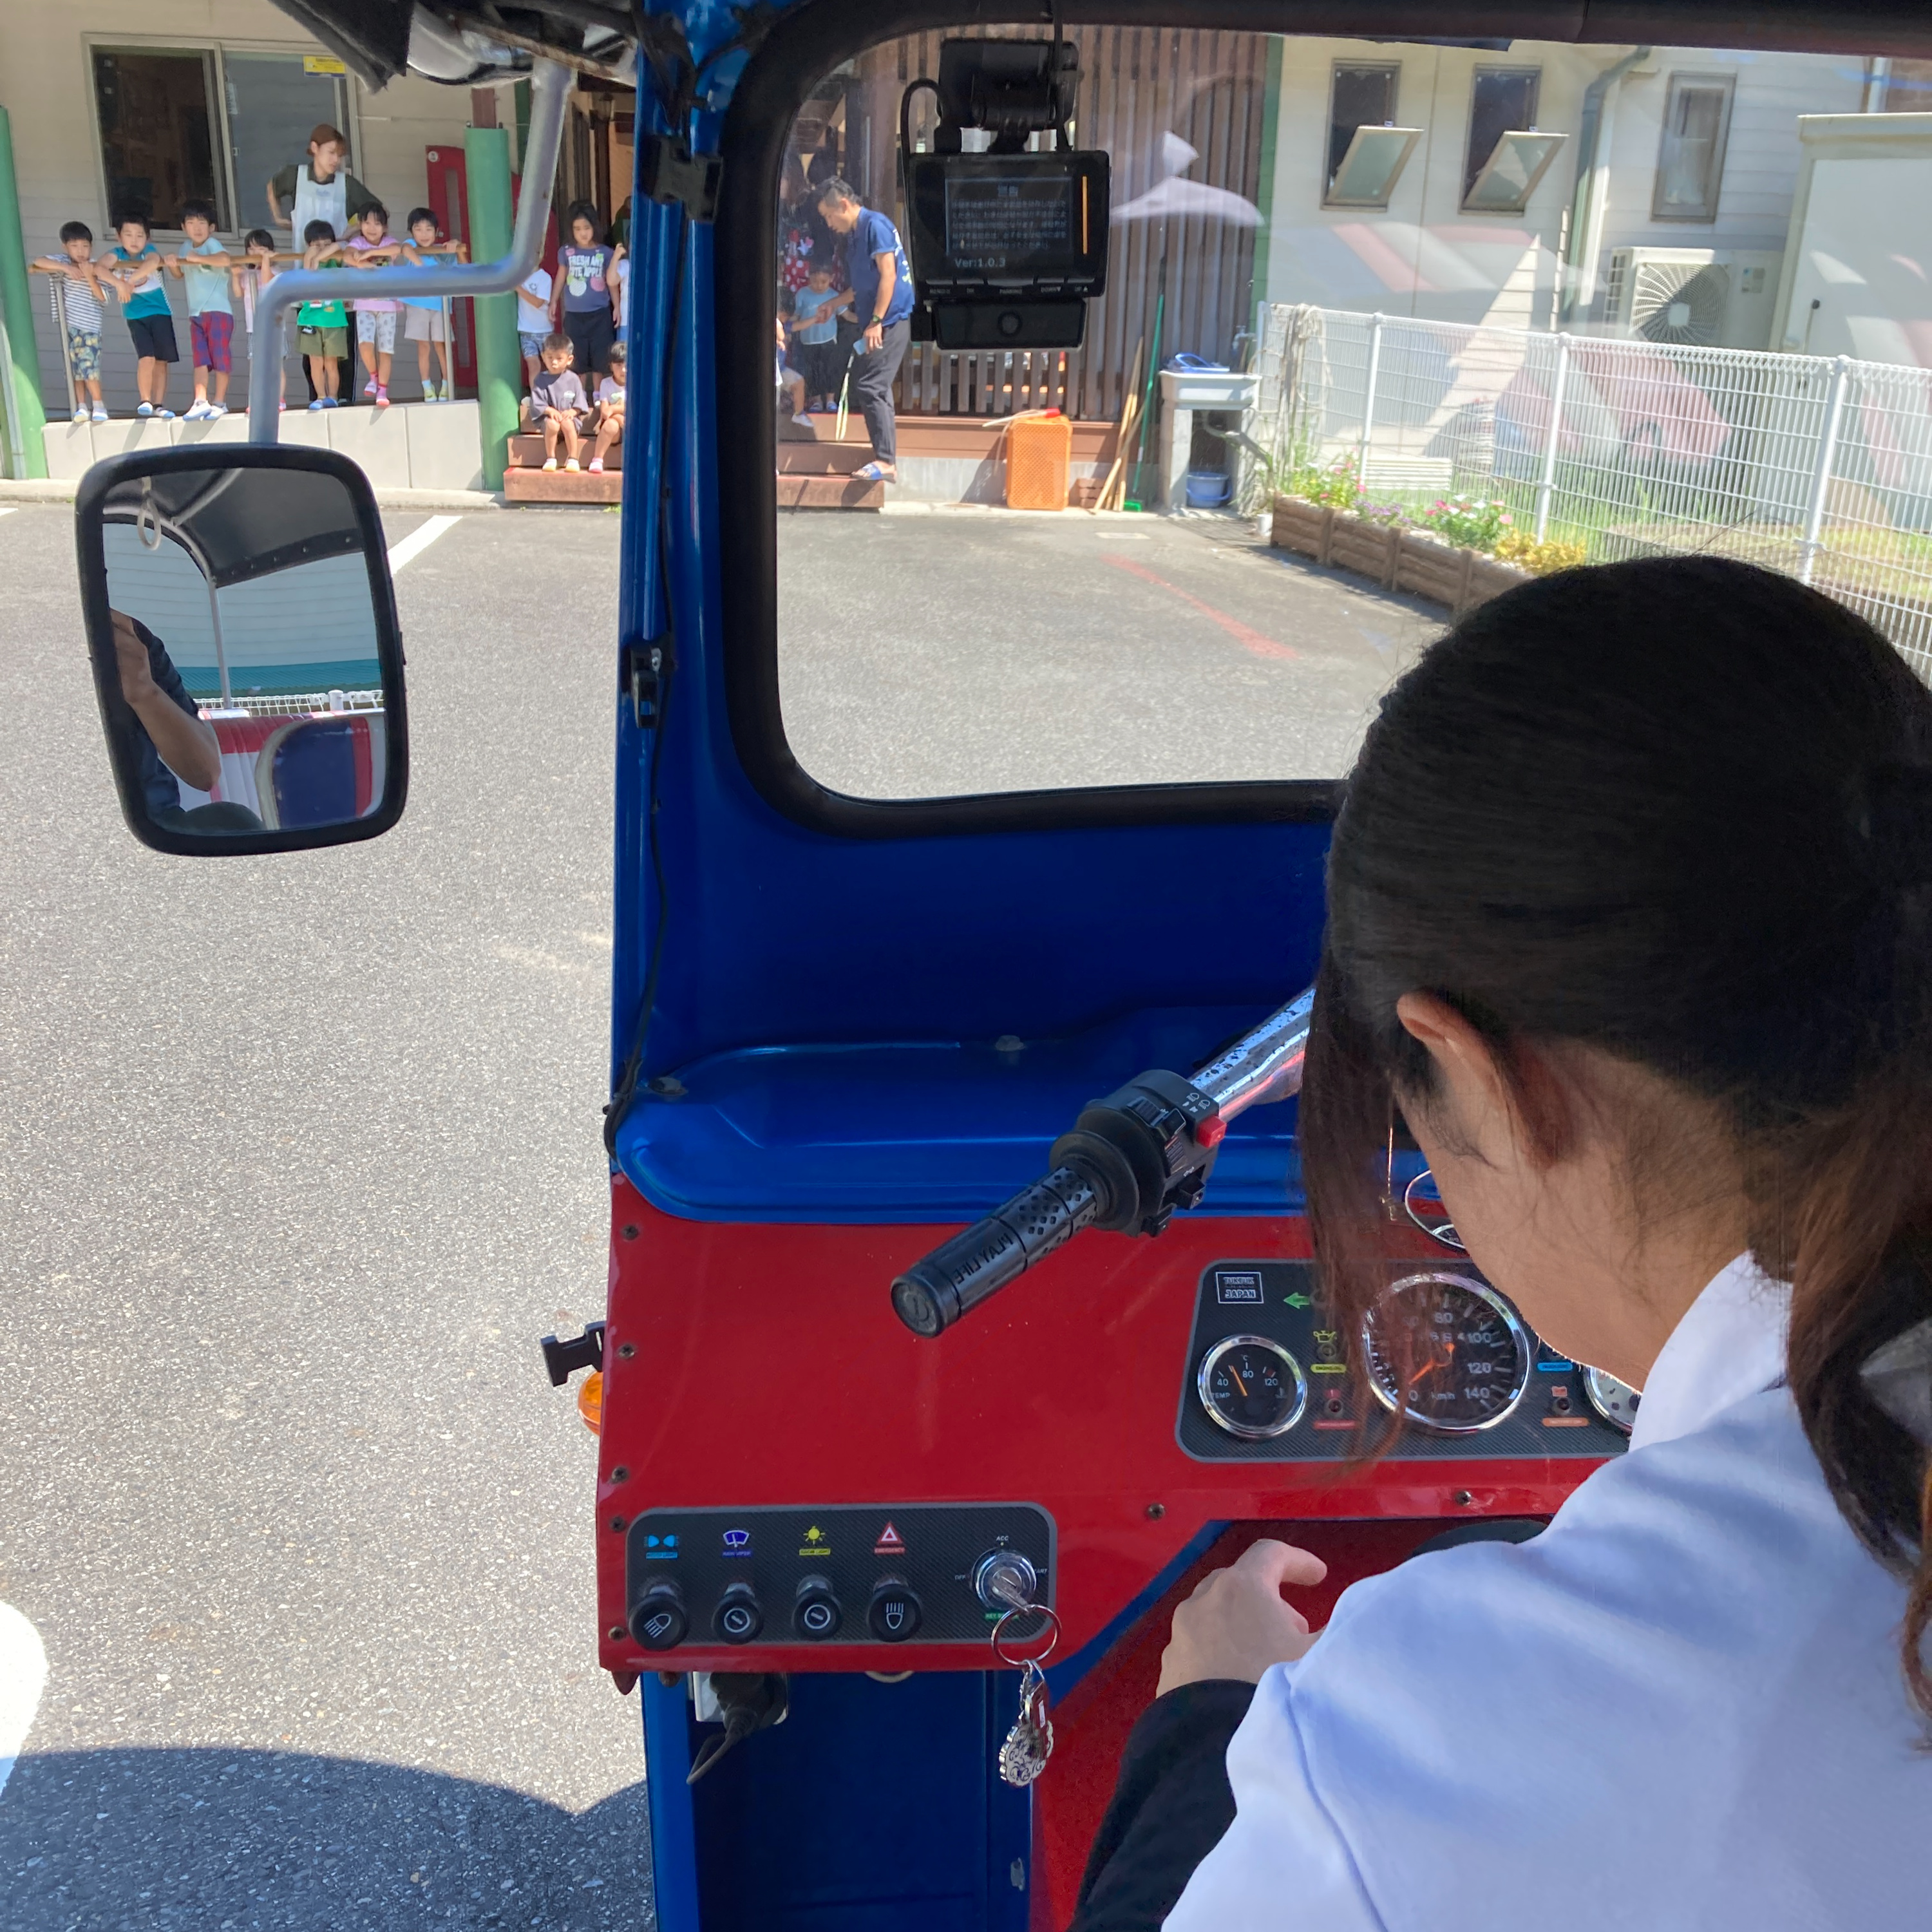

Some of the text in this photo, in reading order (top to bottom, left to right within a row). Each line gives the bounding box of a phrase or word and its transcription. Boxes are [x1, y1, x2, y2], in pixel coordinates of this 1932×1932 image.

[954, 258, 1006, 268] Ver:1.0.3
[1225, 1290, 1256, 1299] JAPAN
[1434, 1312, 1454, 1324] 80
[1468, 1332, 1492, 1344] 100
[1468, 1362, 1492, 1374] 120
[1242, 1370, 1254, 1378] 80
[1217, 1378, 1229, 1387] 40
[1264, 1378, 1278, 1387] 120
[1408, 1390, 1419, 1402] 0
[1465, 1387, 1490, 1399] 140
